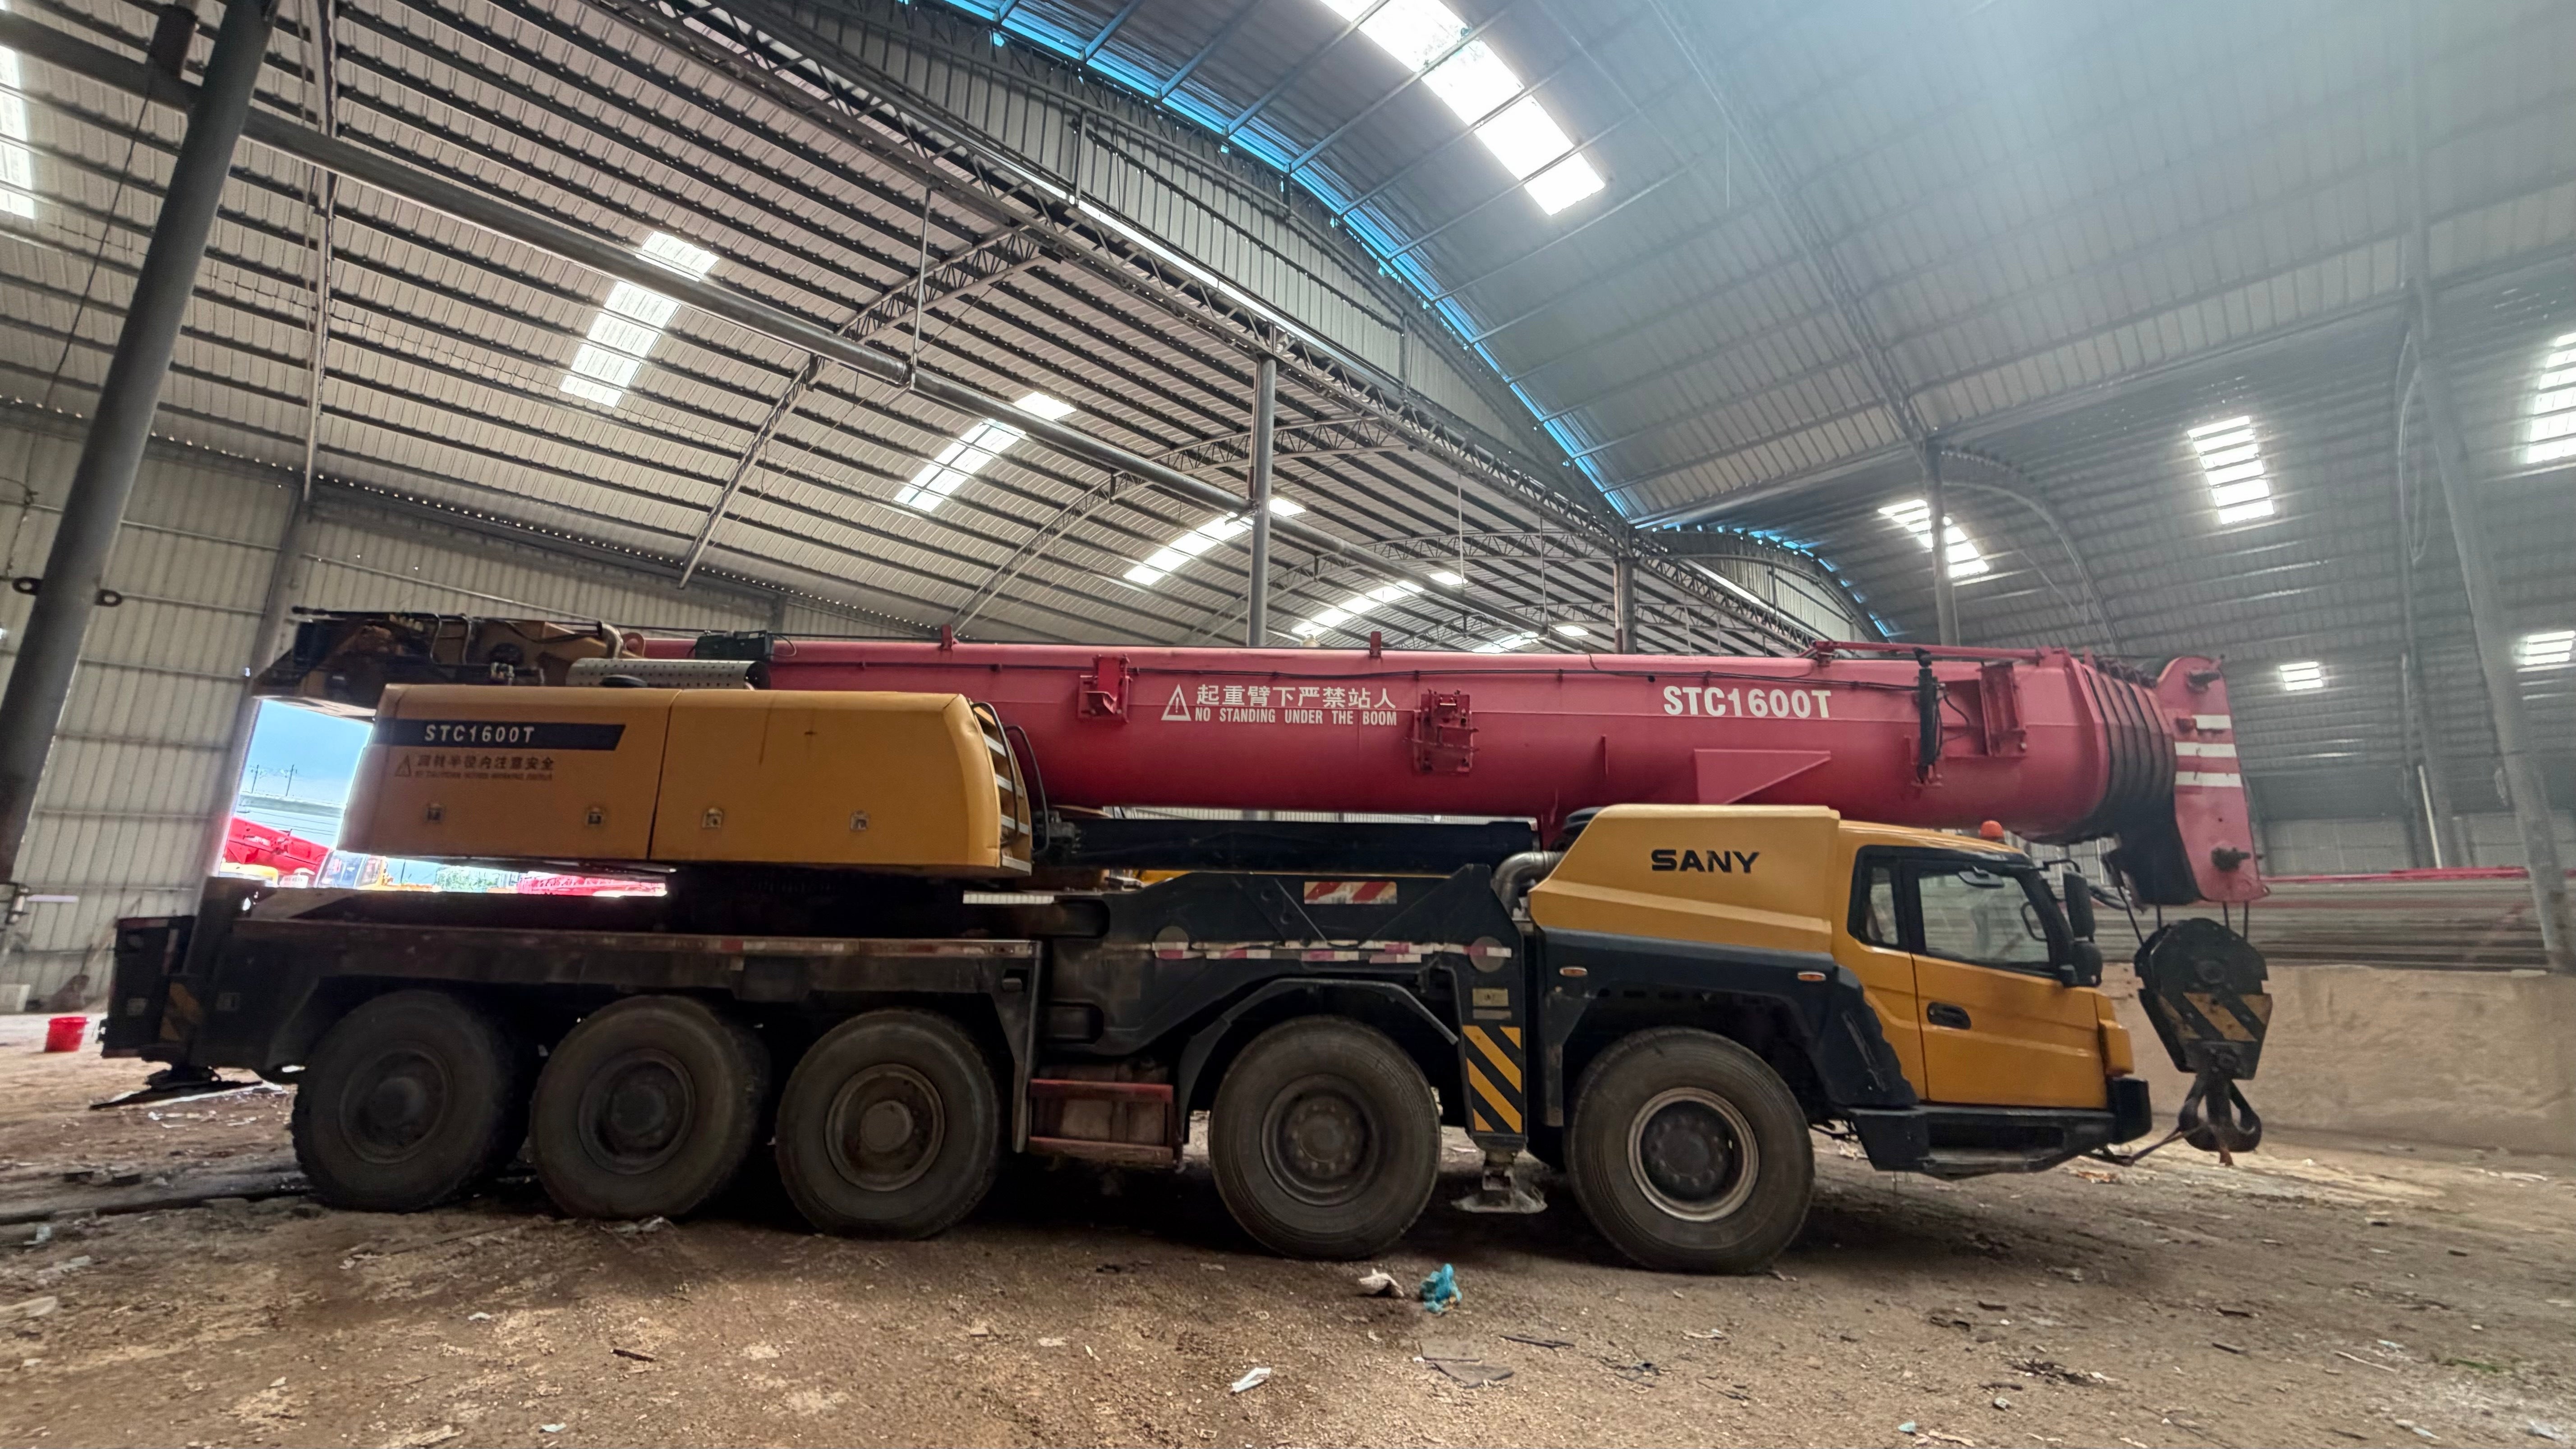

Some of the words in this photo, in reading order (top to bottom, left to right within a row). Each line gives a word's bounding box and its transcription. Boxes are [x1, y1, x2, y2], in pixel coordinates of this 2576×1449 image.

[1196, 684, 1396, 709] 起重臂下严禁站人
[1663, 685, 1832, 718] STC1600T
[1195, 707, 1211, 722] NO
[1219, 707, 1276, 723] STANDING
[1284, 708, 1323, 724] UNDER
[1331, 710, 1353, 725] THE
[1362, 710, 1397, 726] BOOM
[424, 724, 535, 743] STC1600T
[1651, 849, 1760, 874] SANY
